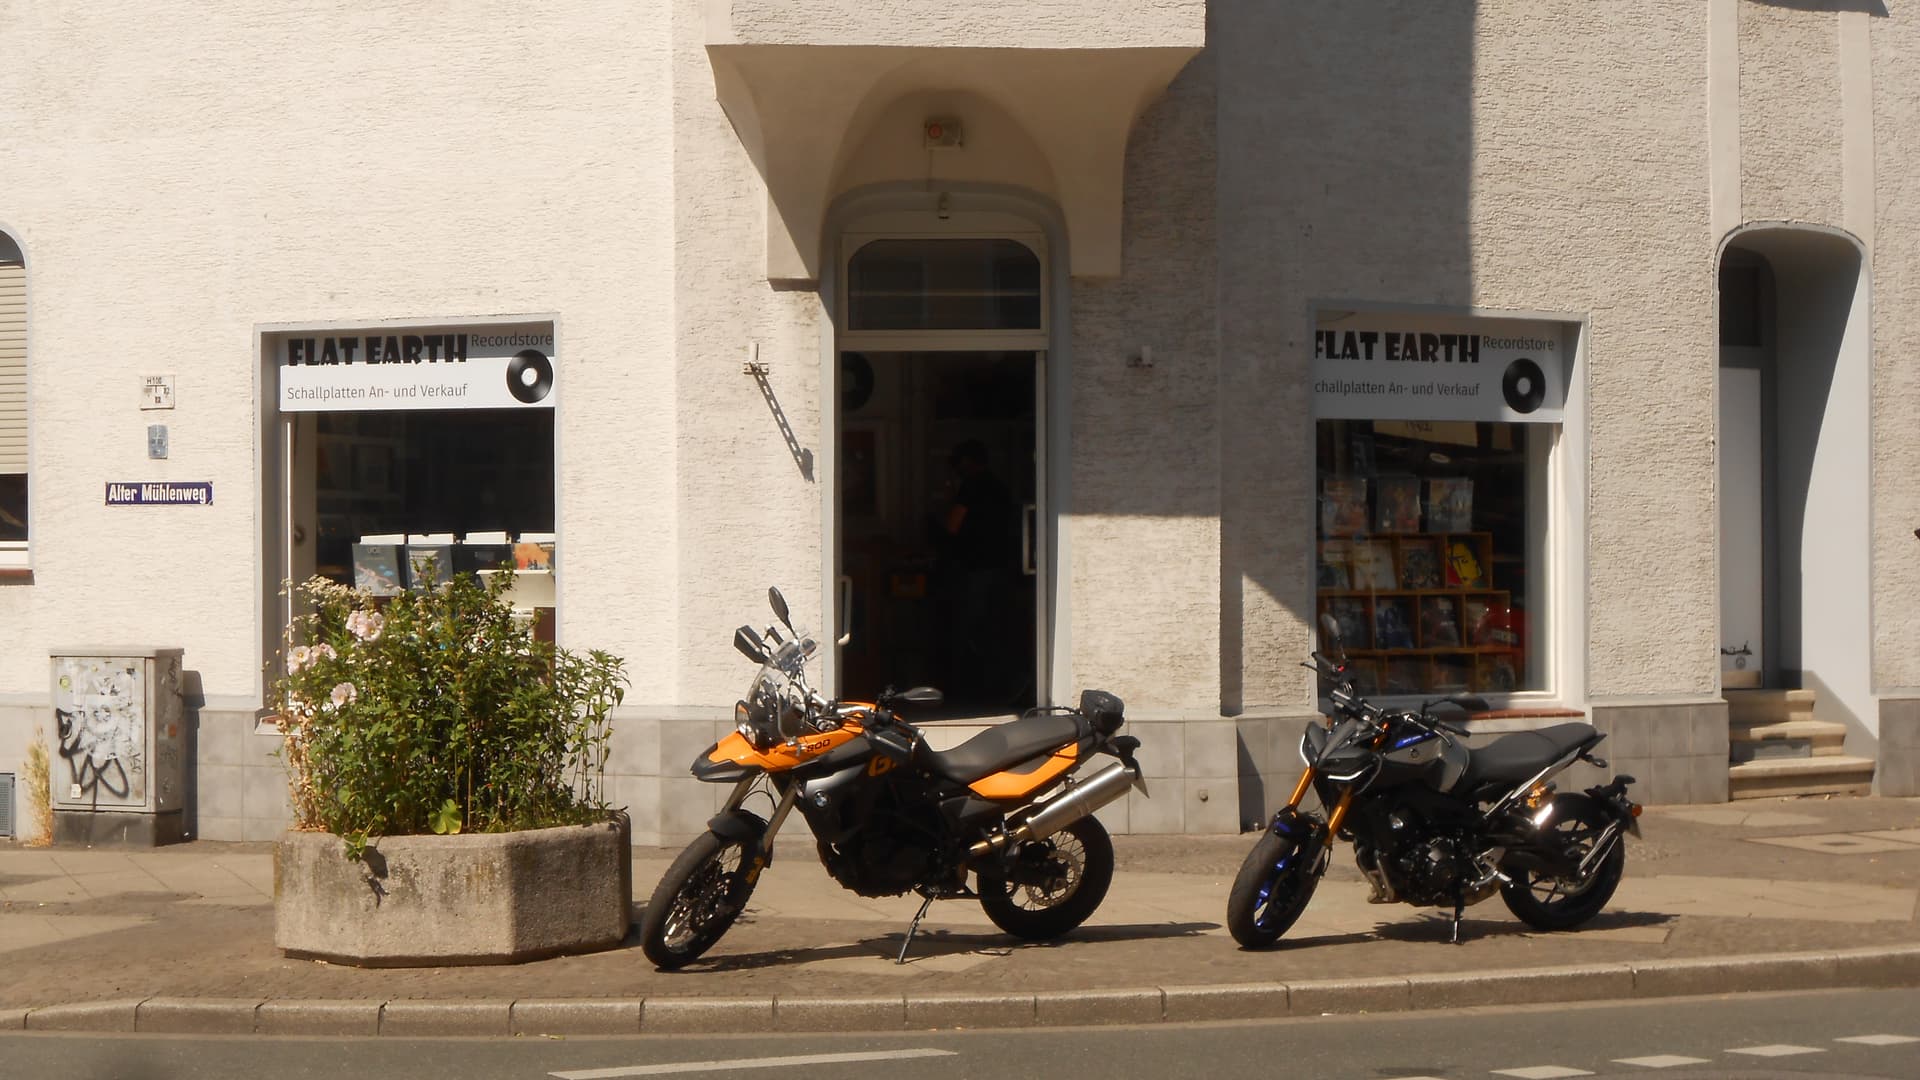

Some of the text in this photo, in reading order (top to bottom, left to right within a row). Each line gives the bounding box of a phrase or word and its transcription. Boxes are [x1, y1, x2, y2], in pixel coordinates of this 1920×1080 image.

[471, 331, 553, 347] Recordstore
[1385, 332, 1480, 363] EARTH
[1483, 335, 1555, 351] Recordstore
[288, 334, 467, 366] FLAT EARTH
[287, 383, 468, 401] Schallplatten An- und Verkauf
[1314, 380, 1480, 397] challplatten An- und Verkauf
[109, 484, 206, 504] Alter Mühlenweg
